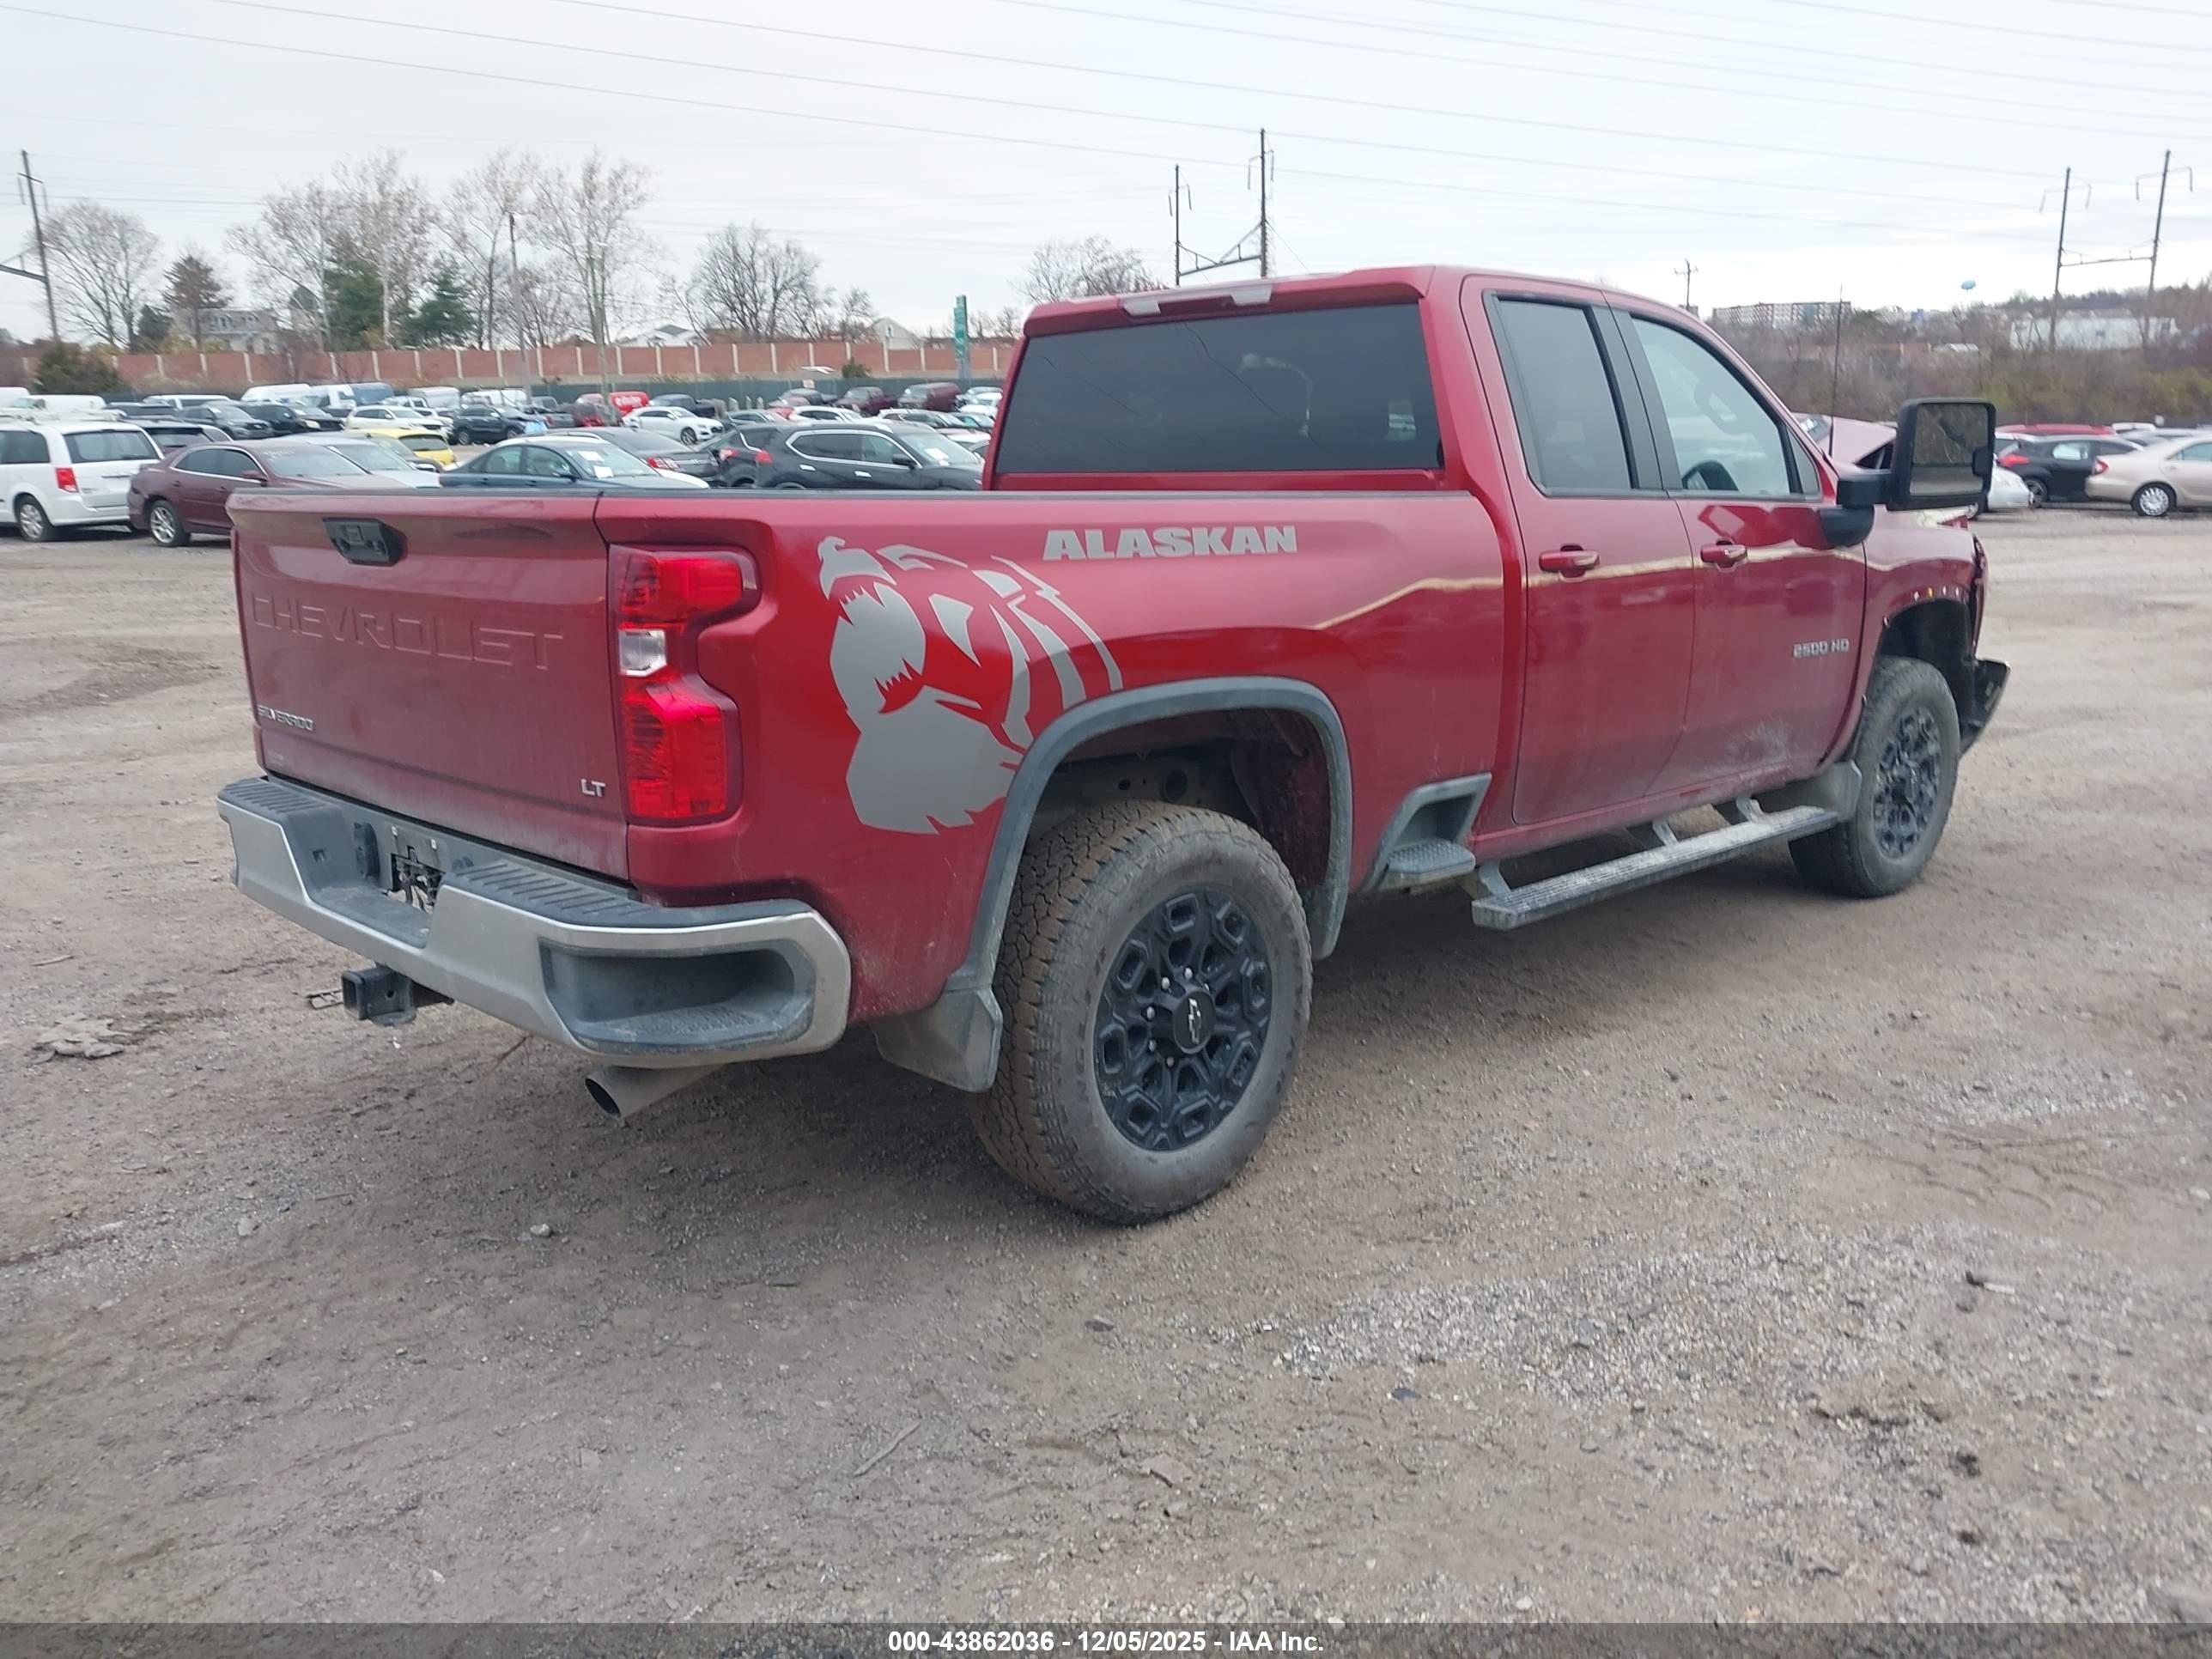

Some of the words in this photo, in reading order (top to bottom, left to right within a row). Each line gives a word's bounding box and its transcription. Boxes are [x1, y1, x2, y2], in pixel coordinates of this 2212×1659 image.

[1042, 526, 1297, 561] ALASKAN
[252, 593, 563, 670] CHEVROLET
[1793, 641, 1827, 659] 2500
[580, 778, 606, 798] LT
